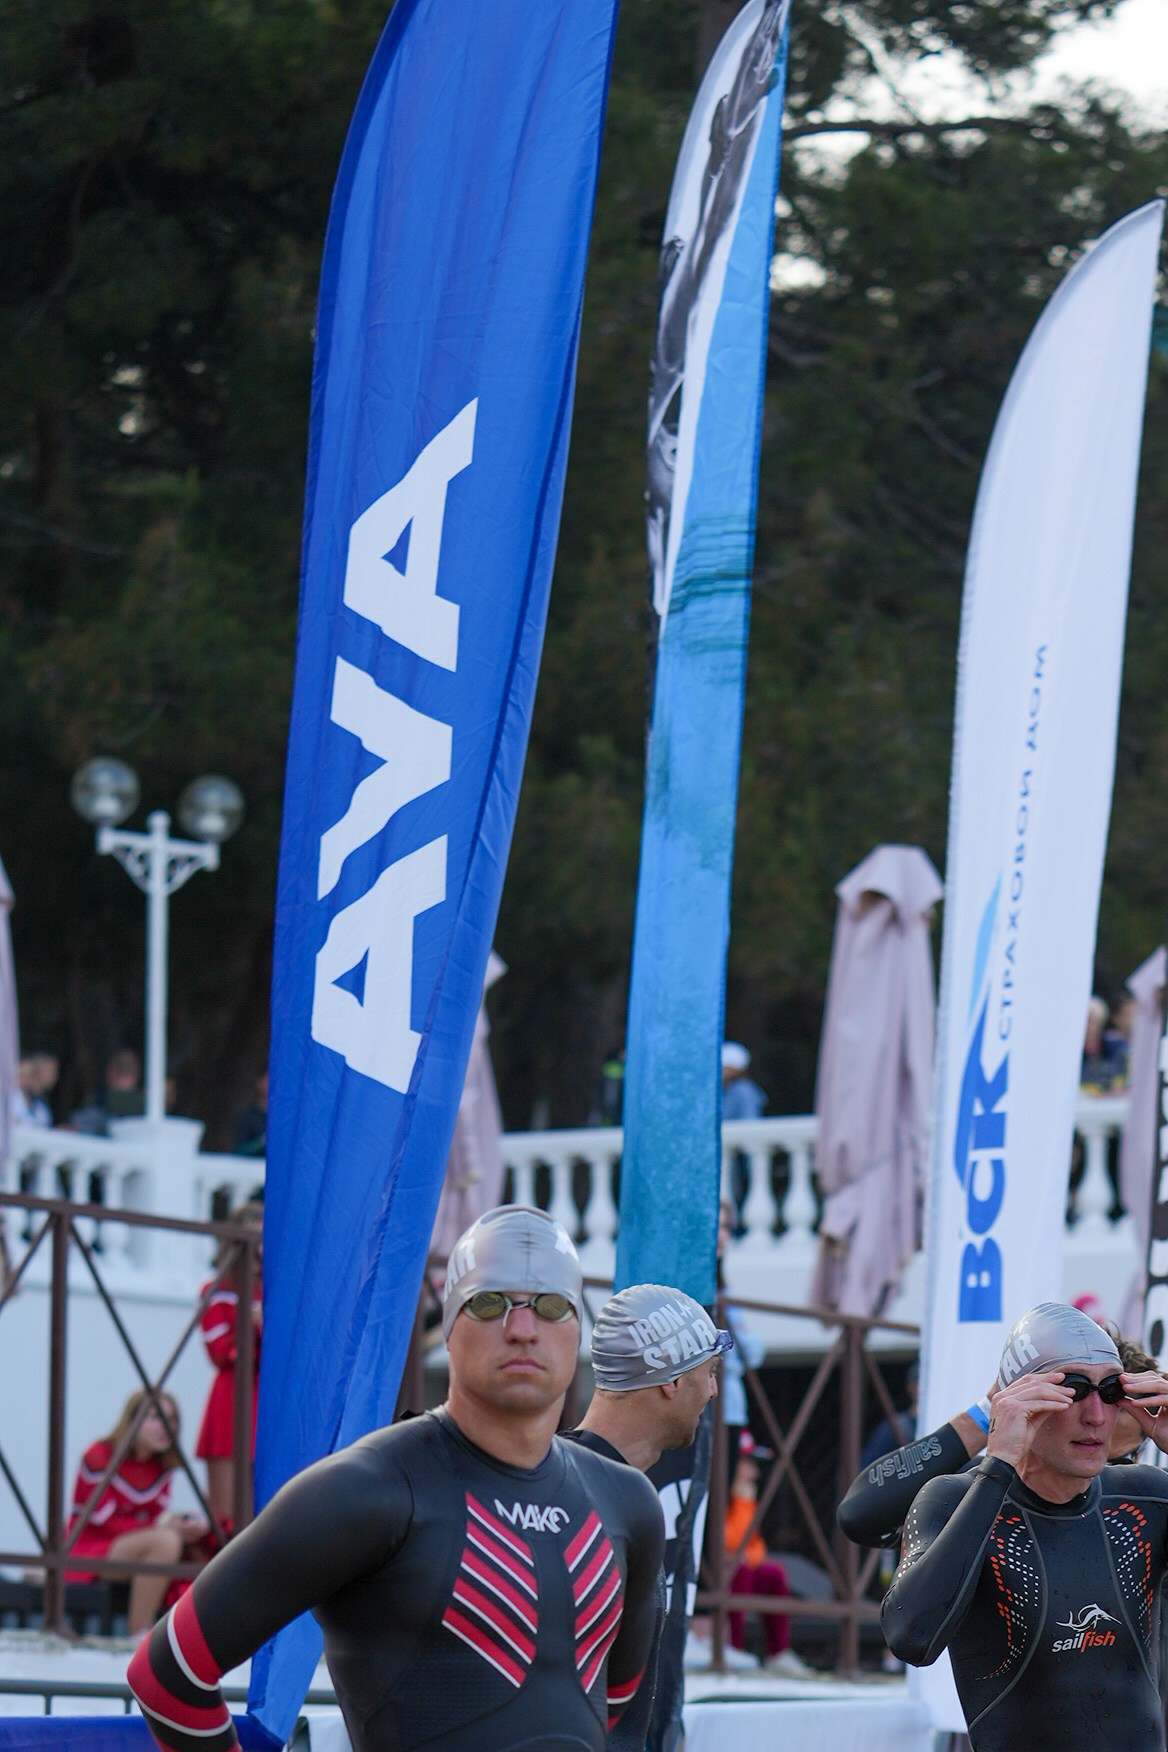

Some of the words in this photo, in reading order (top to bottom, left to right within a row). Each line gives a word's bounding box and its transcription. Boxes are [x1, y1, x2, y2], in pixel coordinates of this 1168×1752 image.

[311, 397, 479, 1094] AVA
[627, 1303, 686, 1348] IRON
[643, 1318, 716, 1374] STAR
[1000, 1333, 1040, 1390] AR
[868, 1436, 942, 1487] sailfish
[1051, 1630, 1116, 1653] sailfish
